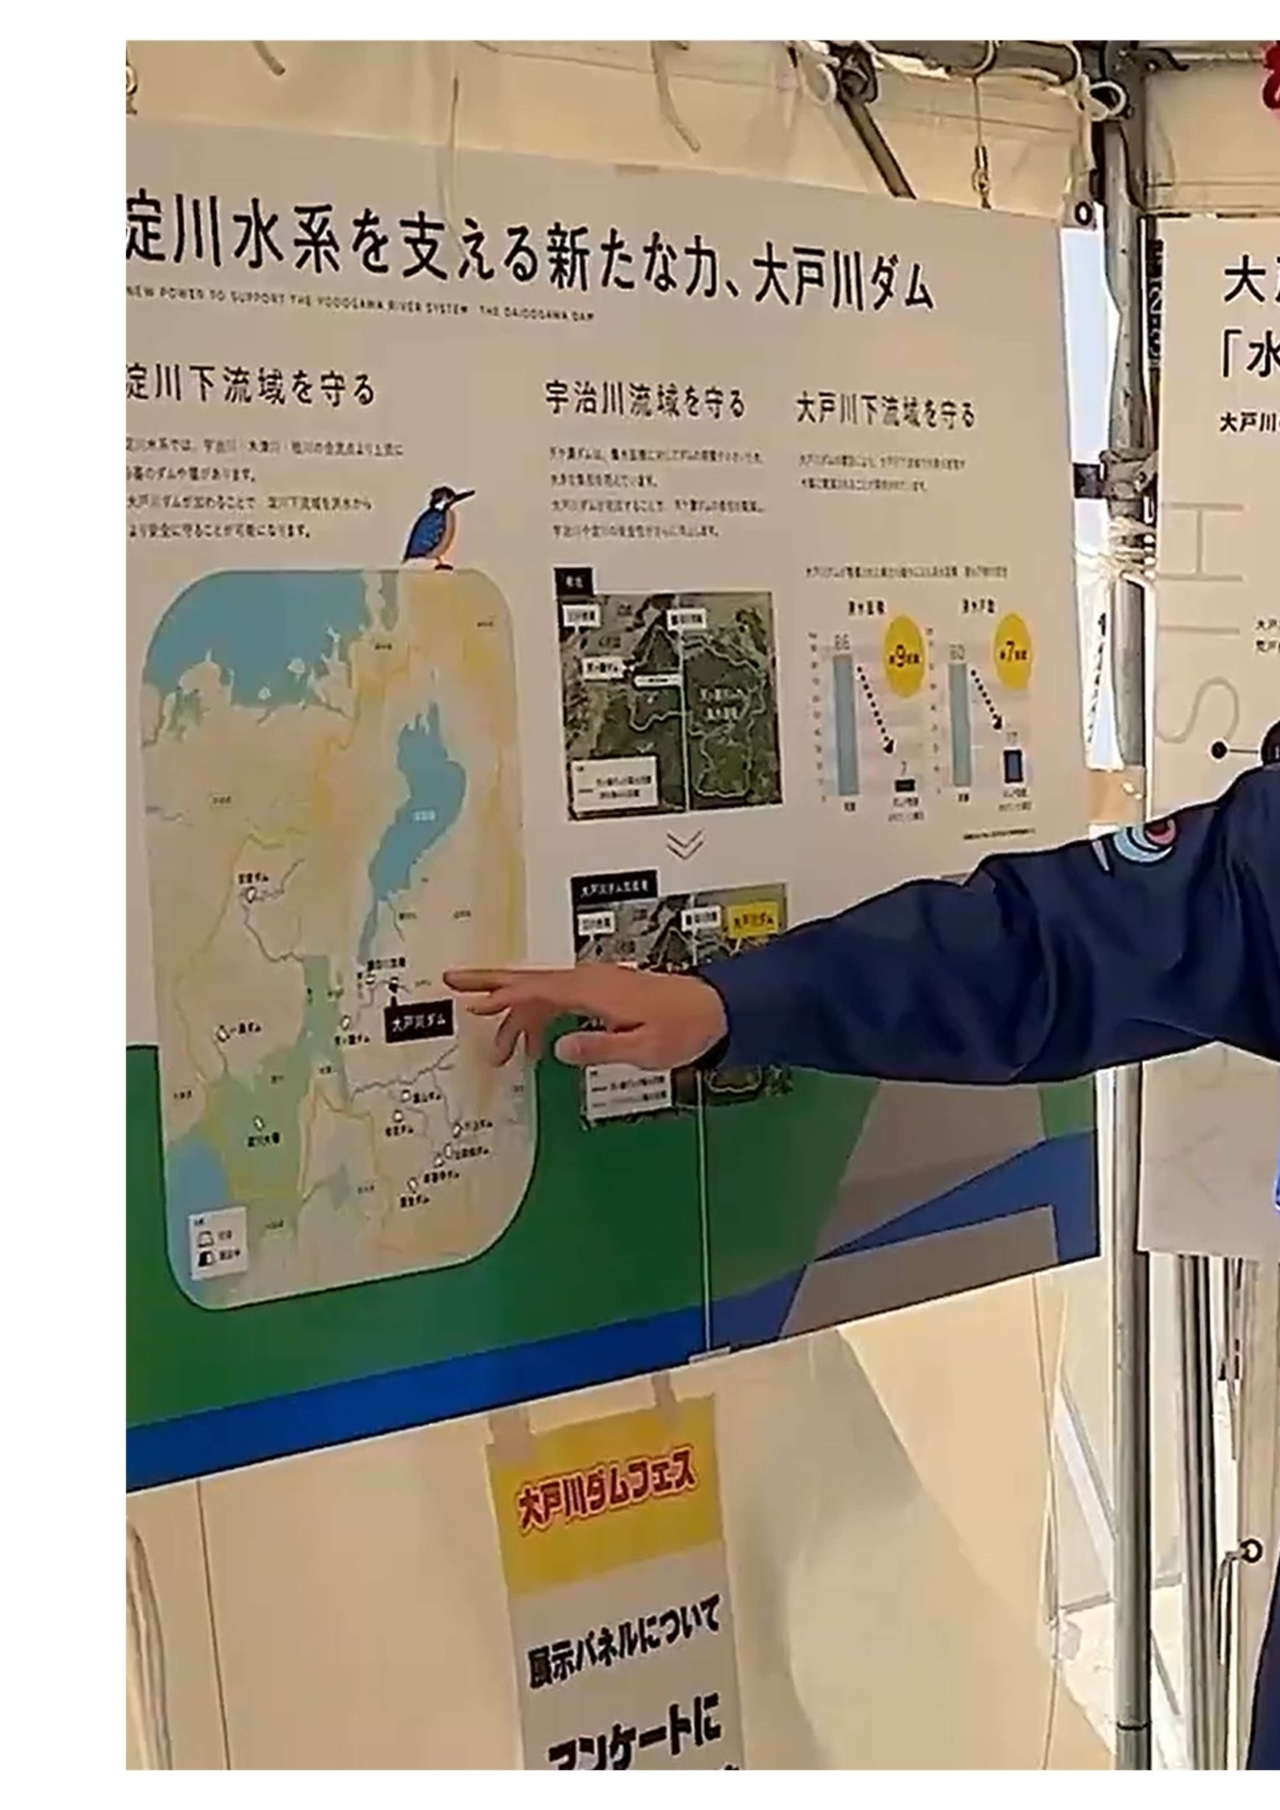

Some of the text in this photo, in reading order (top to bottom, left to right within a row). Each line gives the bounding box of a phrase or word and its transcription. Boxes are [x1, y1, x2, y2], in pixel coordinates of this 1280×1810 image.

[126, 188, 935, 310] 淀川水系を支える新たな力、大戸川ダム
[126, 362, 376, 407] 淀川下流域を守る
[545, 379, 746, 420] 宇治川流域を守る
[796, 390, 976, 430] 大戸川下流域を守る
[516, 1446, 698, 1533] 大戸川ダムフェス
[527, 1593, 721, 1689] 展示パネルについて
[548, 1692, 722, 1771] アンケートに
